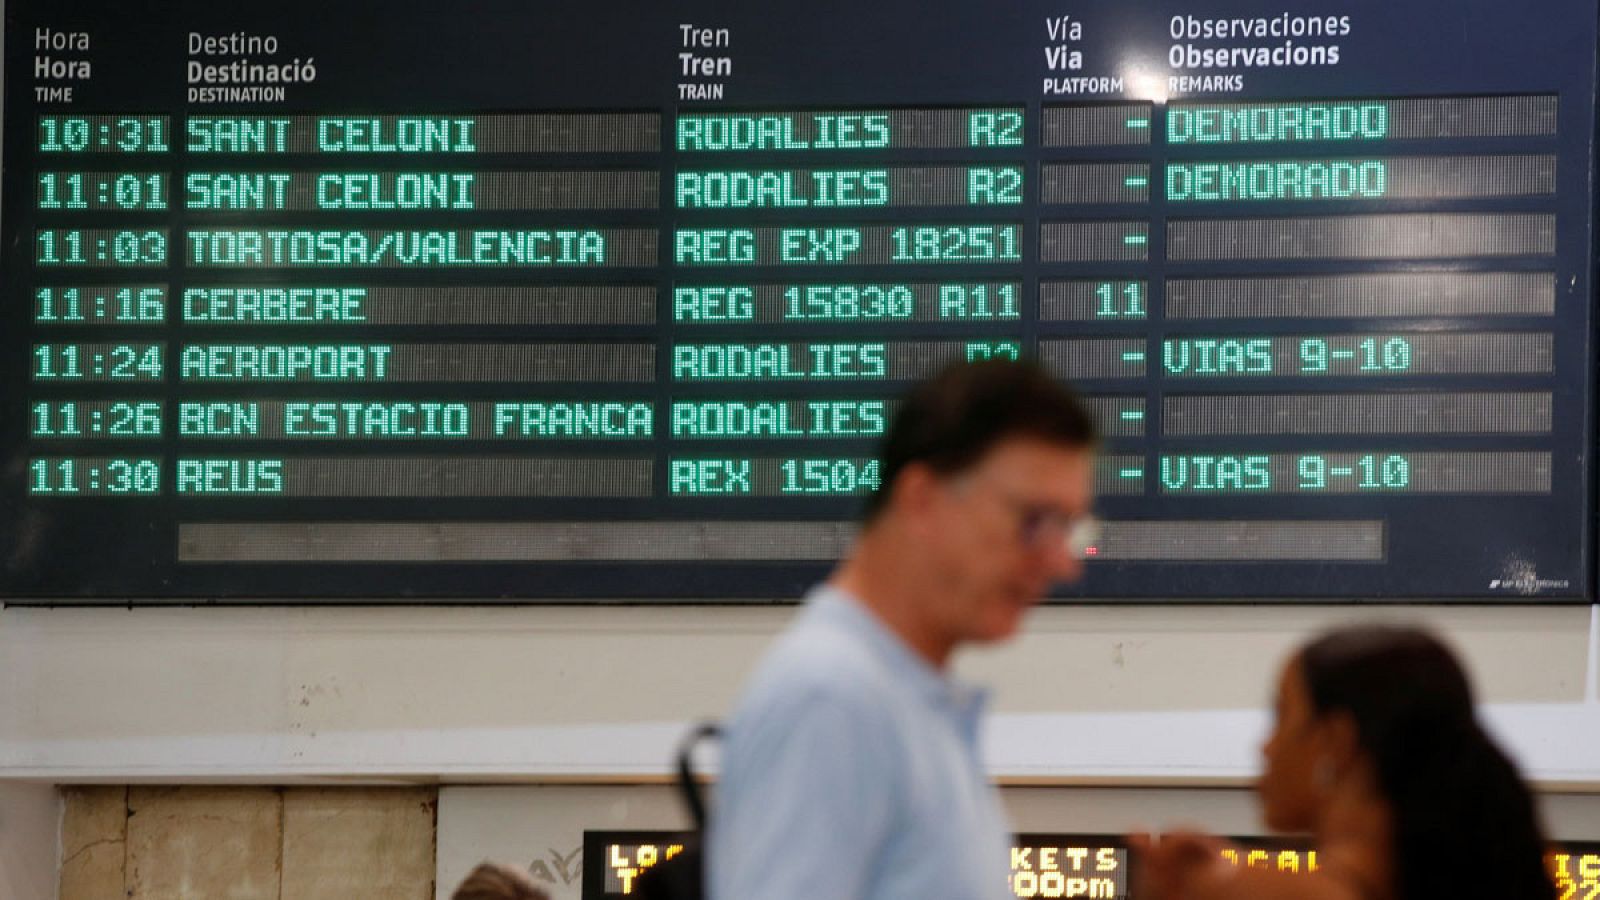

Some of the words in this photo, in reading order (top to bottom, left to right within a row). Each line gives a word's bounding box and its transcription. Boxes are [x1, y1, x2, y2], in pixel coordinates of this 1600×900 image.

[36, 29, 88, 48] Hora
[680, 25, 728, 46] Tren
[1047, 16, 1081, 40] Vía
[1170, 12, 1350, 39] Observaciones
[190, 32, 276, 53] Destino
[1045, 45, 1082, 69] Via
[1168, 40, 1340, 68] Observacions
[36, 57, 89, 77] Hora
[188, 59, 315, 82] Destinació
[679, 53, 731, 75] Tren
[36, 88, 71, 101] TIME
[189, 88, 284, 101] DESTINATION
[679, 84, 723, 99] TRAIN
[1043, 77, 1124, 95] PLATFORM
[1168, 75, 1244, 92] REMARKS
[42, 120, 167, 151] 10:31
[188, 120, 290, 151] SANT
[320, 120, 475, 152] CELONI
[678, 114, 889, 150] RODALIES
[968, 111, 1022, 146] R2
[1168, 105, 1388, 143] DEMORADO
[41, 174, 166, 208] 11:01
[188, 174, 290, 208] SANT
[318, 174, 473, 208] CELONI
[677, 170, 888, 207] RODALIES
[968, 168, 1021, 203] R2
[1168, 161, 1387, 200] DEMORADO
[40, 232, 164, 262] 11:03
[189, 231, 603, 265] TORTOSA/VALENCIA
[676, 229, 754, 264] REG
[780, 229, 861, 261] EXP
[892, 226, 1020, 261] 18251
[38, 288, 163, 320] 11:16
[184, 288, 366, 320] CERBERE
[676, 288, 752, 321] REG
[785, 285, 912, 320] 15830
[941, 285, 1019, 318] R11
[1095, 283, 1146, 318] 11
[36, 346, 161, 377] 11:24
[183, 346, 390, 378] AEROPORT
[675, 344, 885, 377] RODALIES
[1164, 339, 1273, 375] VIAS
[1299, 336, 1412, 374] 9-10
[34, 403, 160, 434] 11:26
[181, 403, 257, 434] BCN
[284, 403, 468, 435] ESTACIO
[496, 403, 652, 435] FRANCA
[673, 402, 883, 437] RODALIES
[32, 460, 158, 491] 11:30
[178, 460, 282, 492] REUS
[672, 460, 750, 492] REX
[1162, 456, 1270, 490] VIAS
[1297, 454, 1409, 489] 9-10
